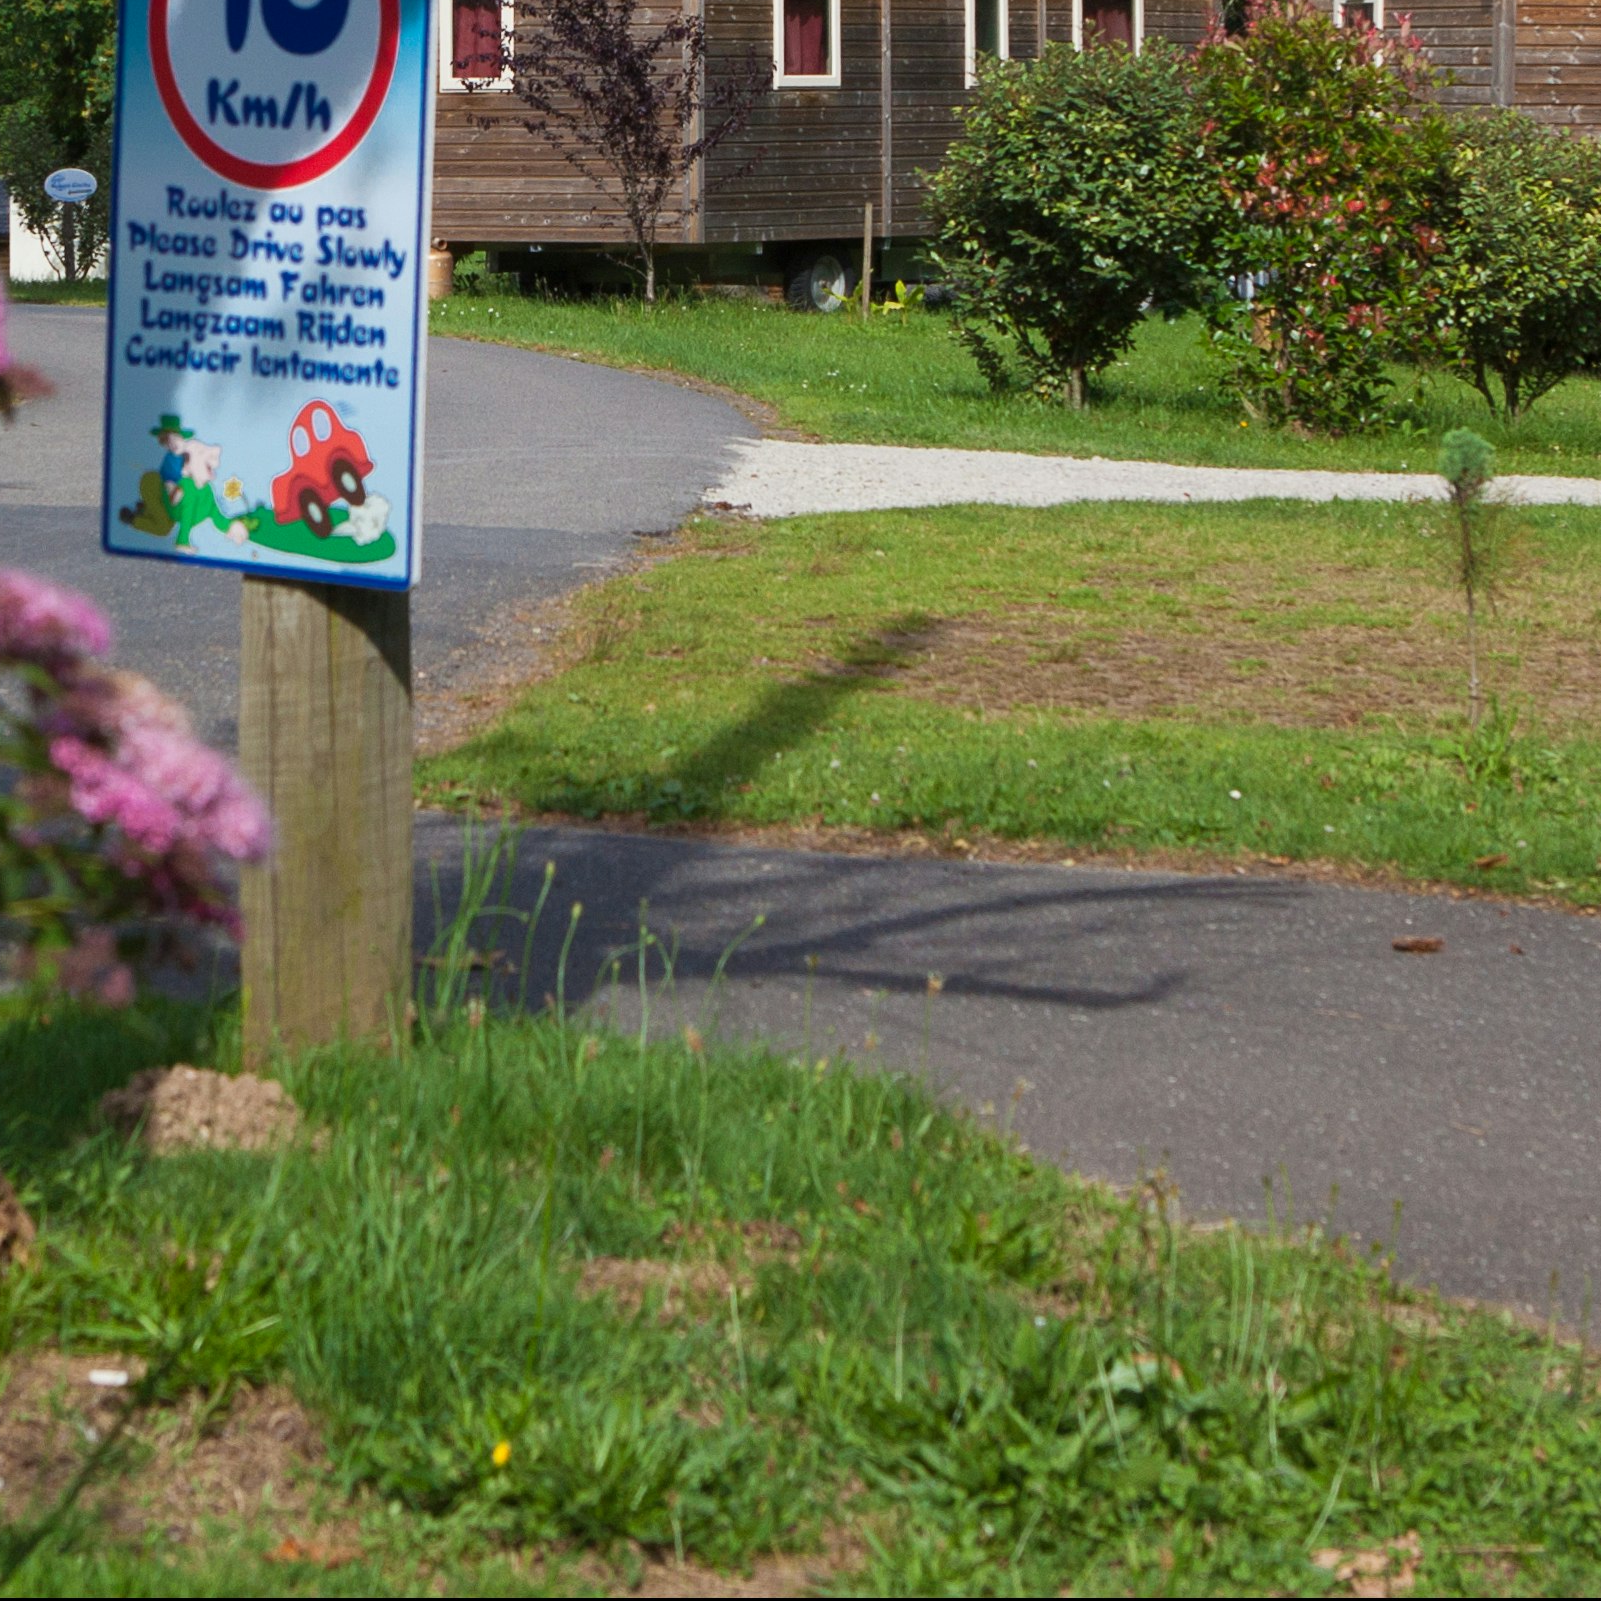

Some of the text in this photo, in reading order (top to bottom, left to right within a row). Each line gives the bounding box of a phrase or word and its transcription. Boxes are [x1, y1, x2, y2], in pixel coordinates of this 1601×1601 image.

[207, 77, 332, 132] Km/h
[167, 186, 366, 232] Roulez au pas
[127, 221, 406, 279] Please Drive Slowly
[143, 261, 384, 308] Langsam Fahren
[140, 297, 386, 351] Langzaam Rijden
[126, 334, 400, 389] Conducir lentamente
